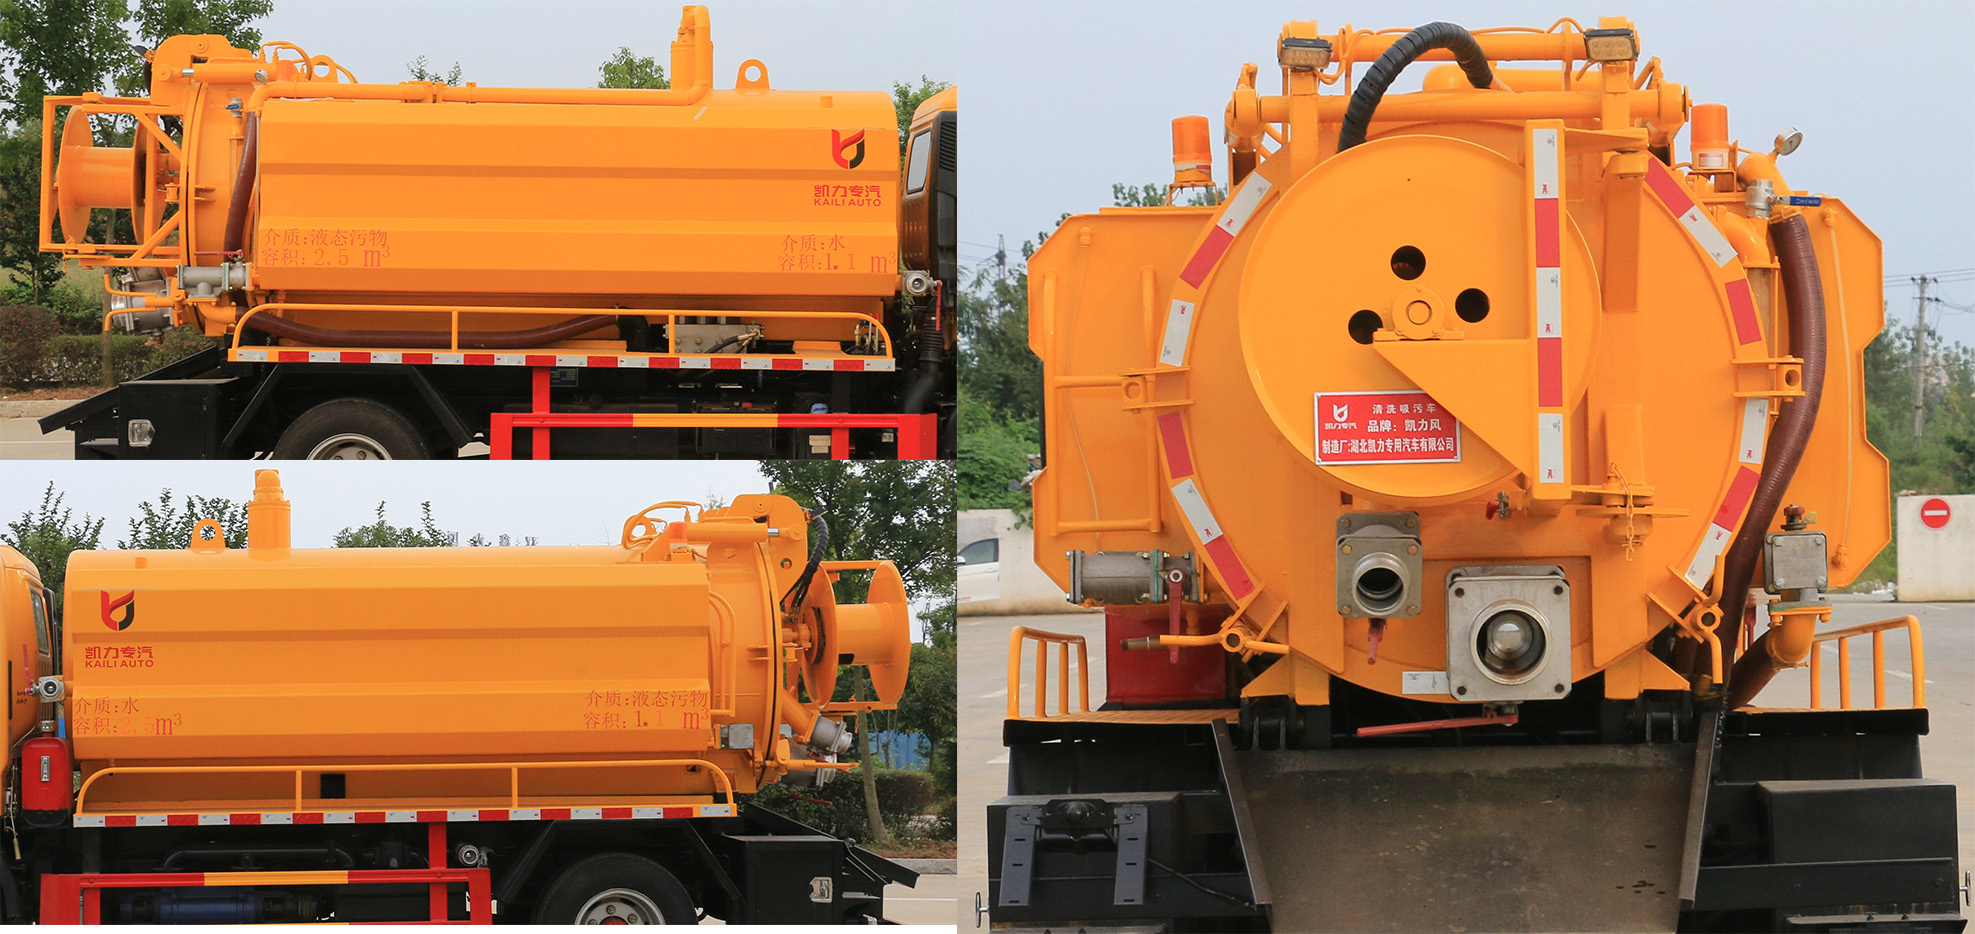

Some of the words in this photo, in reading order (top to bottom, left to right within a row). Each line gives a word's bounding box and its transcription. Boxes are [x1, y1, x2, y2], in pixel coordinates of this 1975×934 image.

[814, 184, 881, 198] 凯力专汽
[814, 198, 845, 206] KAILI
[848, 198, 881, 207] AUTO
[264, 228, 388, 247] 介质:液态污物
[782, 233, 845, 253] 介质:水
[1372, 403, 1437, 415] 清洗吸污车
[85, 646, 154, 659] 凯力专汽
[85, 660, 117, 668] KAILI
[120, 660, 154, 668] AUTO
[74, 696, 140, 715] 介质:水
[585, 689, 708, 708] 介质:液态污物
